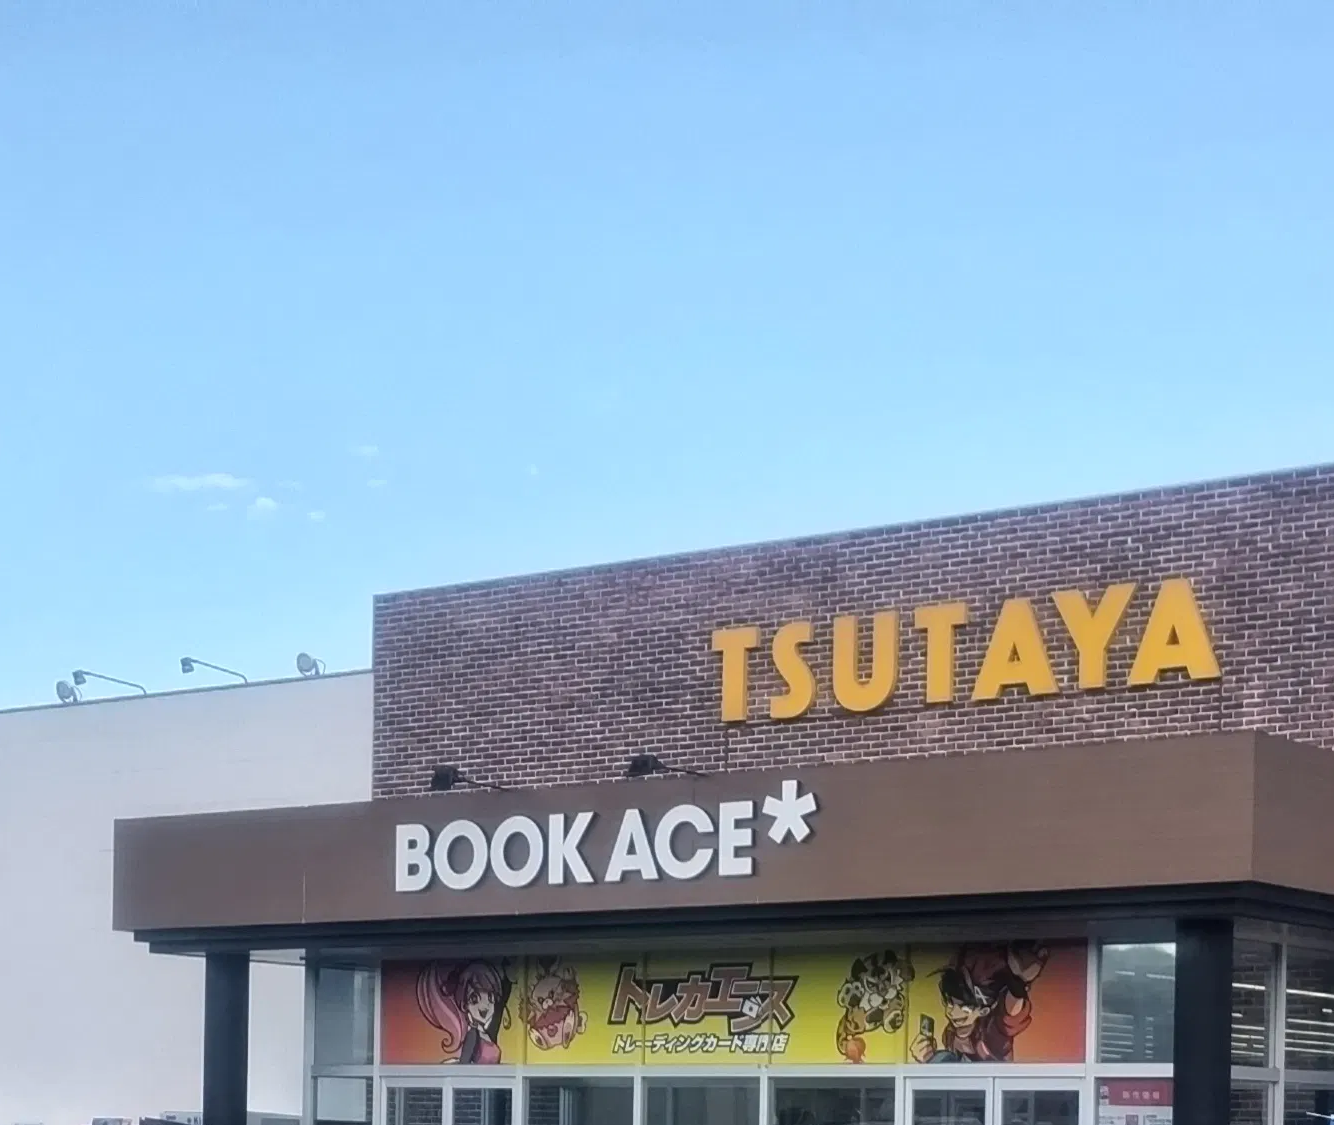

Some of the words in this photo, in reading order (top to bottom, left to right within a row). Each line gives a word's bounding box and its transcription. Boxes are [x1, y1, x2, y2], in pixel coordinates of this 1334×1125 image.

[712, 578, 1222, 722] TSUTAYA
[395, 811, 595, 892] BOOK
[608, 963, 799, 1033] トレカエース
[612, 1033, 791, 1053] トレーディングカード専門店
